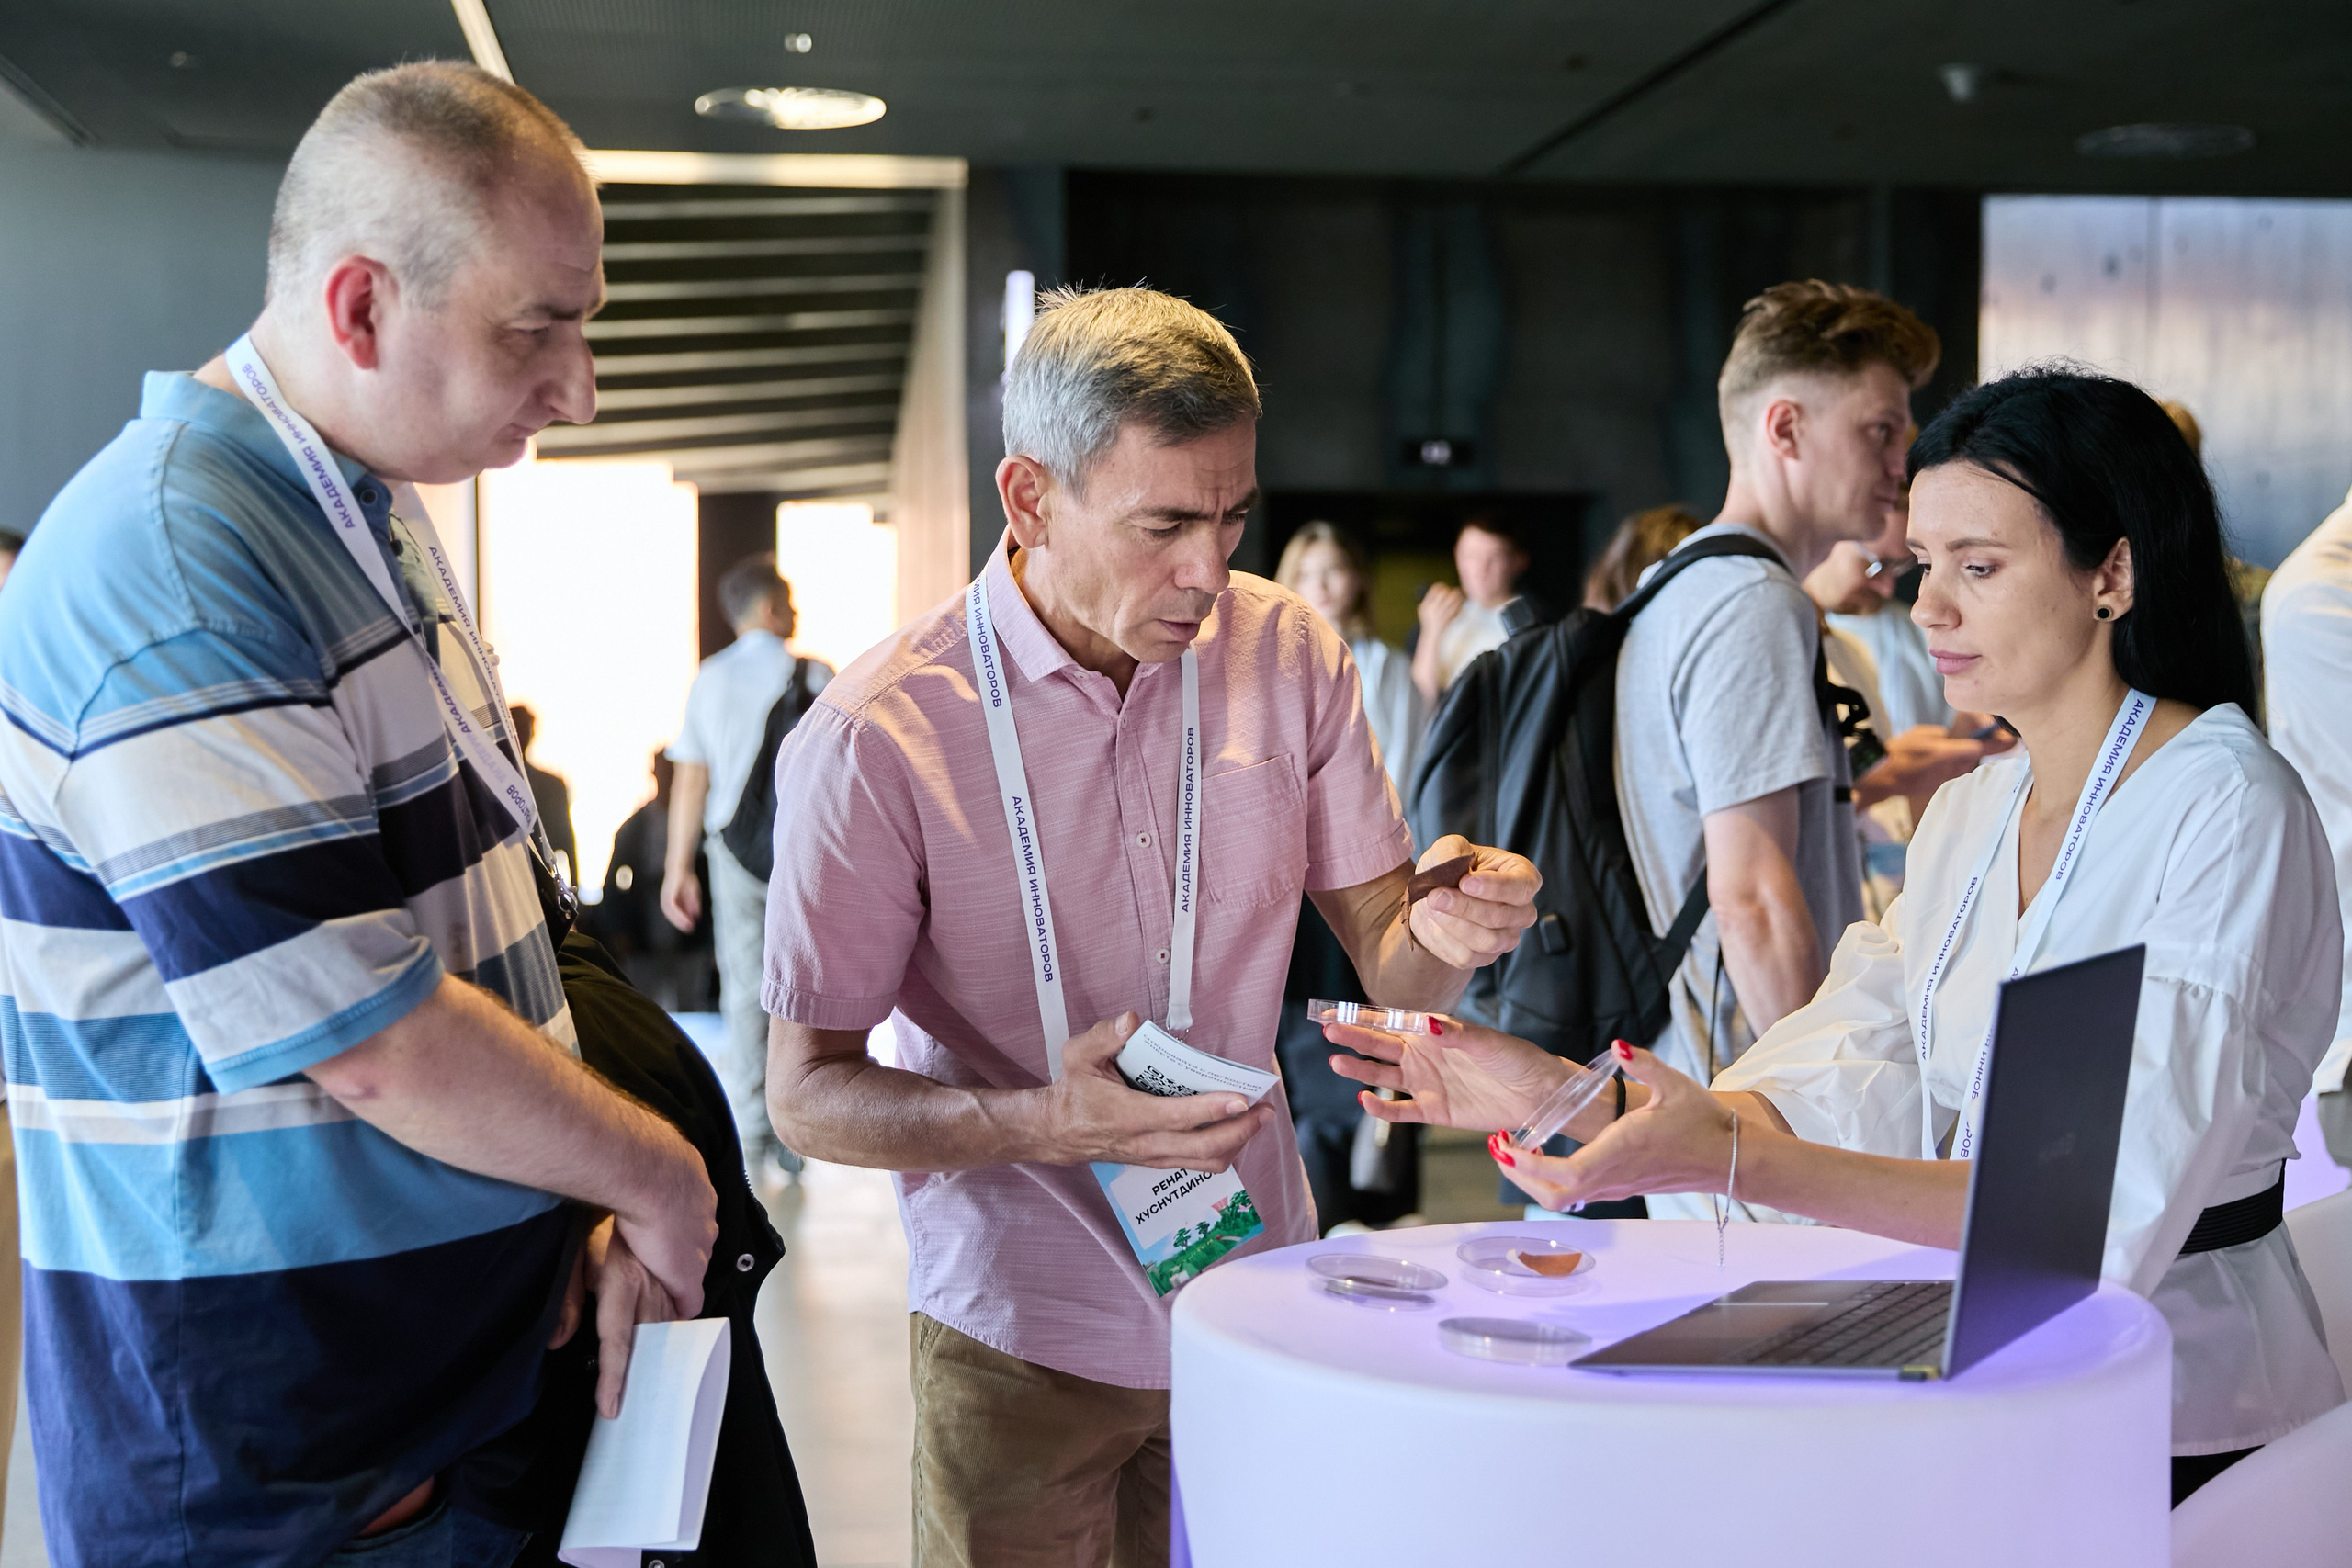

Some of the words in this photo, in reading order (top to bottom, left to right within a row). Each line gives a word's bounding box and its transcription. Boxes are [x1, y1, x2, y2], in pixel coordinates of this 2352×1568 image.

[242, 363, 307, 444] ИННОВАТОРОВ
[302, 446, 356, 529] АКАДЕМИЯ
[429, 547, 470, 627] АКАДЕМИЯ
[974, 607, 1002, 708] ИННОВАТОРОВ
[1184, 727, 1194, 829] ИННОВАТОРОВ
[2101, 698, 2145, 775] АКАДЕМИЯ
[2055, 777, 2107, 880] ИННОВАТОРОВ
[1012, 795, 1036, 875] АКАДЕМИЯ
[1029, 878, 1054, 983] ИННОВАТОРОВ
[1182, 833, 1192, 913] АКАДЕМИЯ
[1921, 979, 1934, 1061] АКАДЕМИЯ
[1932, 876, 1978, 976] ИННОВАТОРОВ
[1960, 1051, 1987, 1159] ИННОВРОВ
[1135, 1171, 1216, 1225] ХУСНУТДИНО
[1151, 1168, 1189, 1196] РЕНАТ
